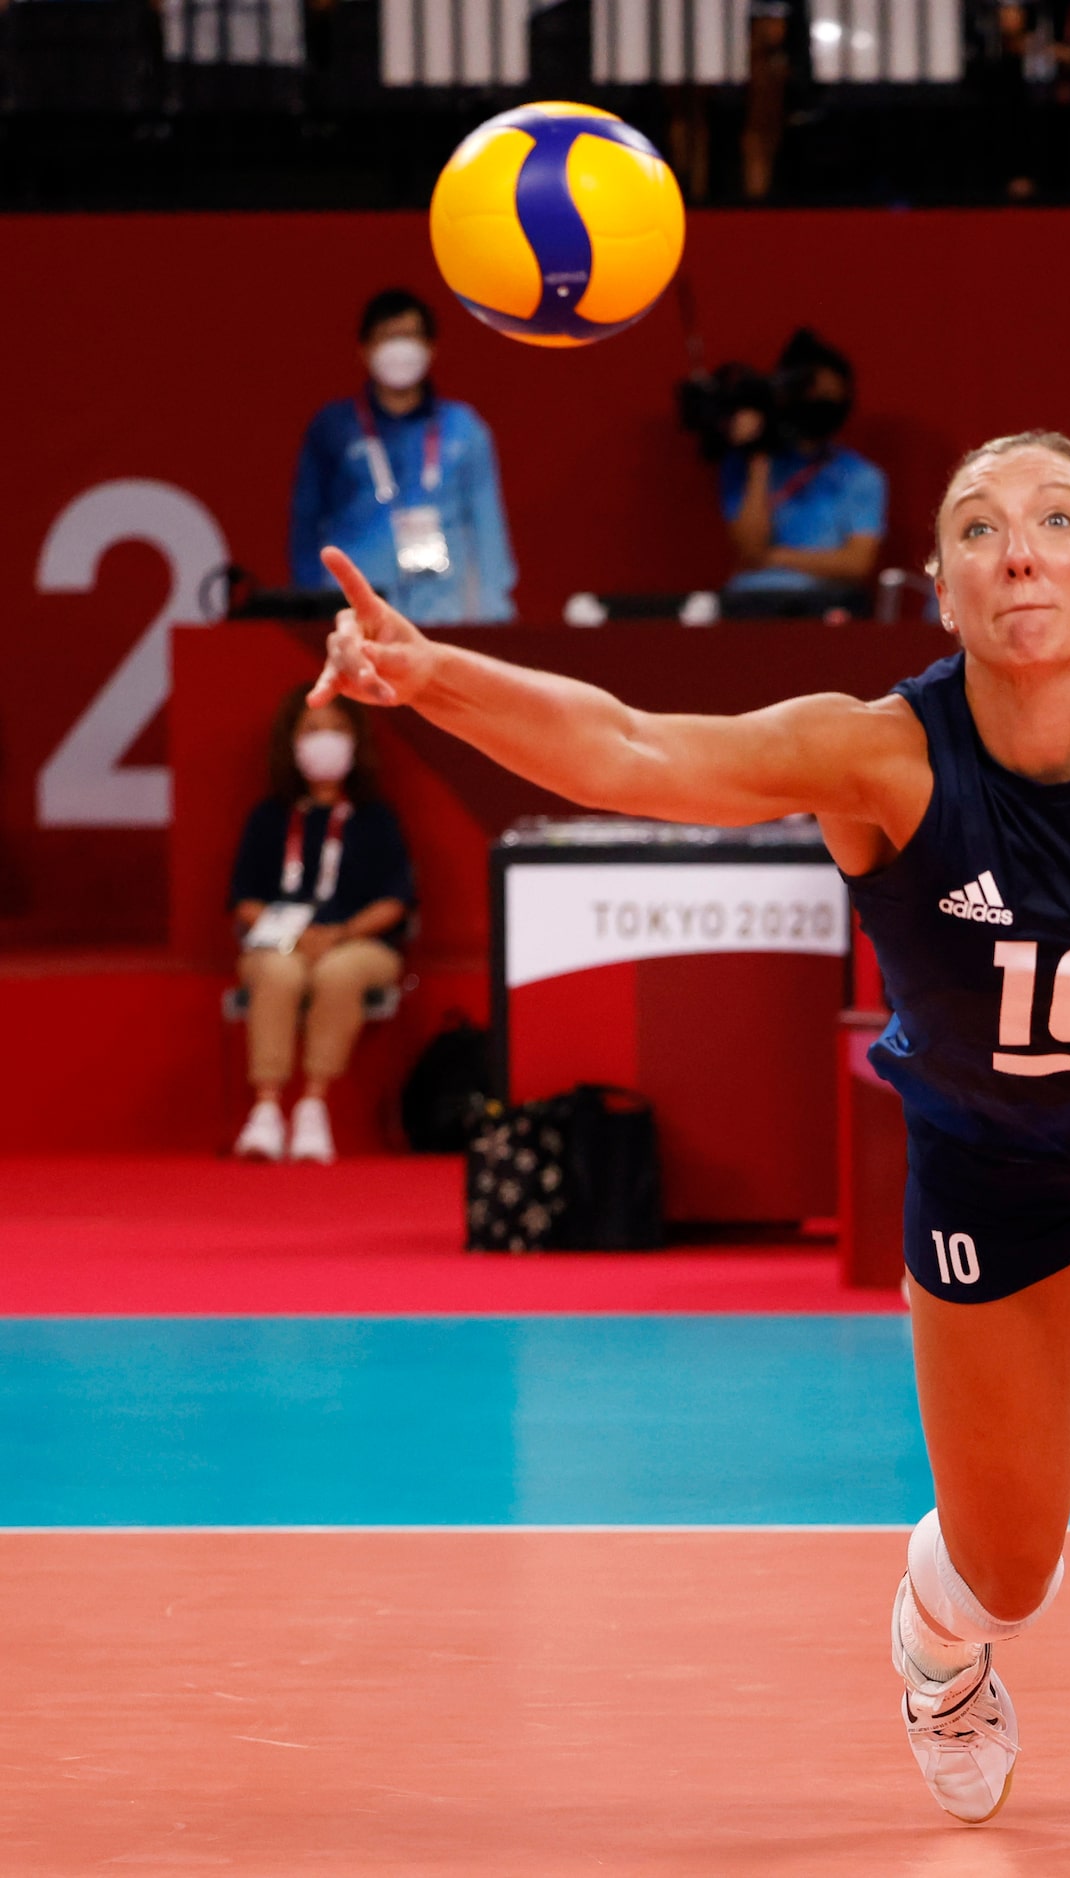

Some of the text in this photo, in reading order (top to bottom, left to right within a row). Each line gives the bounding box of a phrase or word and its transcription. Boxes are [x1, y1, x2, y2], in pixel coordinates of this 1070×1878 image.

[36, 478, 231, 827] 2
[591, 899, 836, 941] TOKYO 2020
[938, 898, 1014, 927] adidas
[931, 1229, 981, 1285] 10
